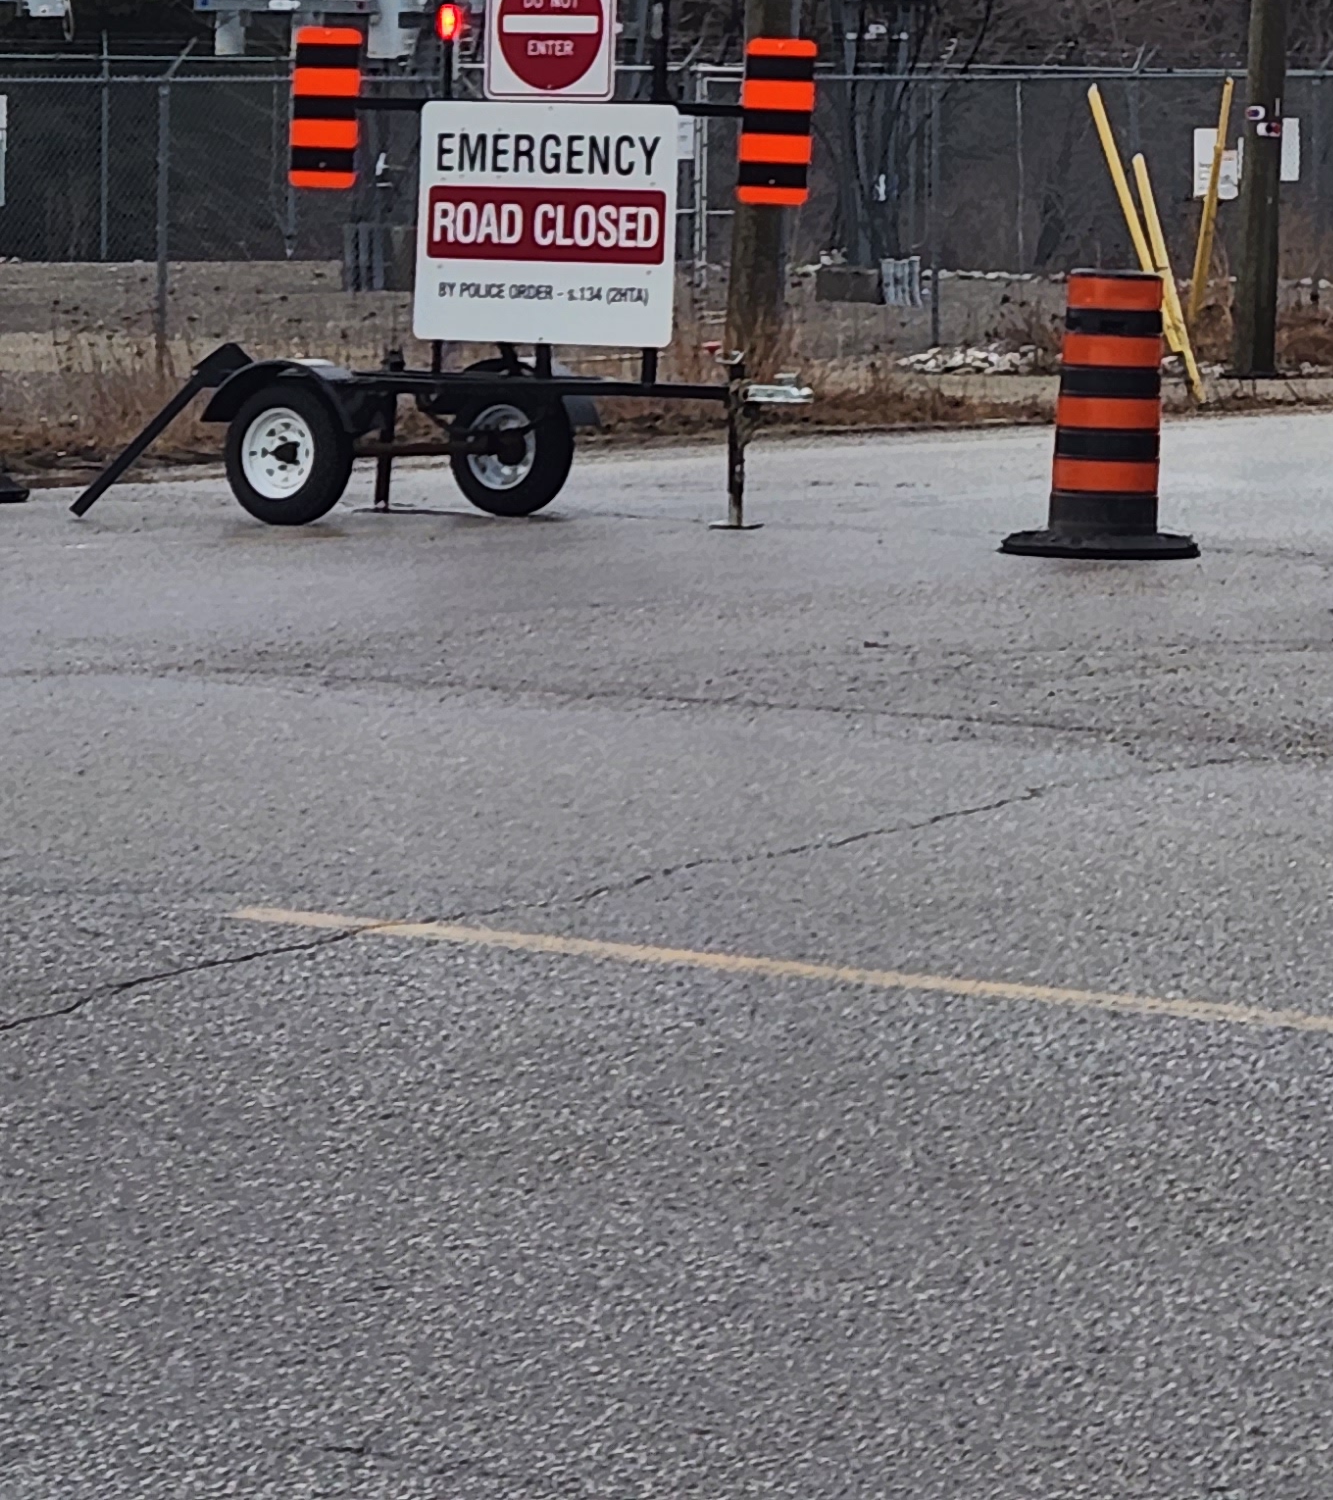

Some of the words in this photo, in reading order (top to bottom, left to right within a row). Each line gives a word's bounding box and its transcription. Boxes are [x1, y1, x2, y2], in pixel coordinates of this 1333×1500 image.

[527, 40, 574, 56] ENTER
[436, 132, 662, 176] EMERGENCY
[433, 202, 524, 245] ROAD
[534, 204, 660, 248] CLOSED
[438, 281, 457, 298] BY
[458, 282, 506, 299] POLICE
[508, 283, 554, 301] ORDER
